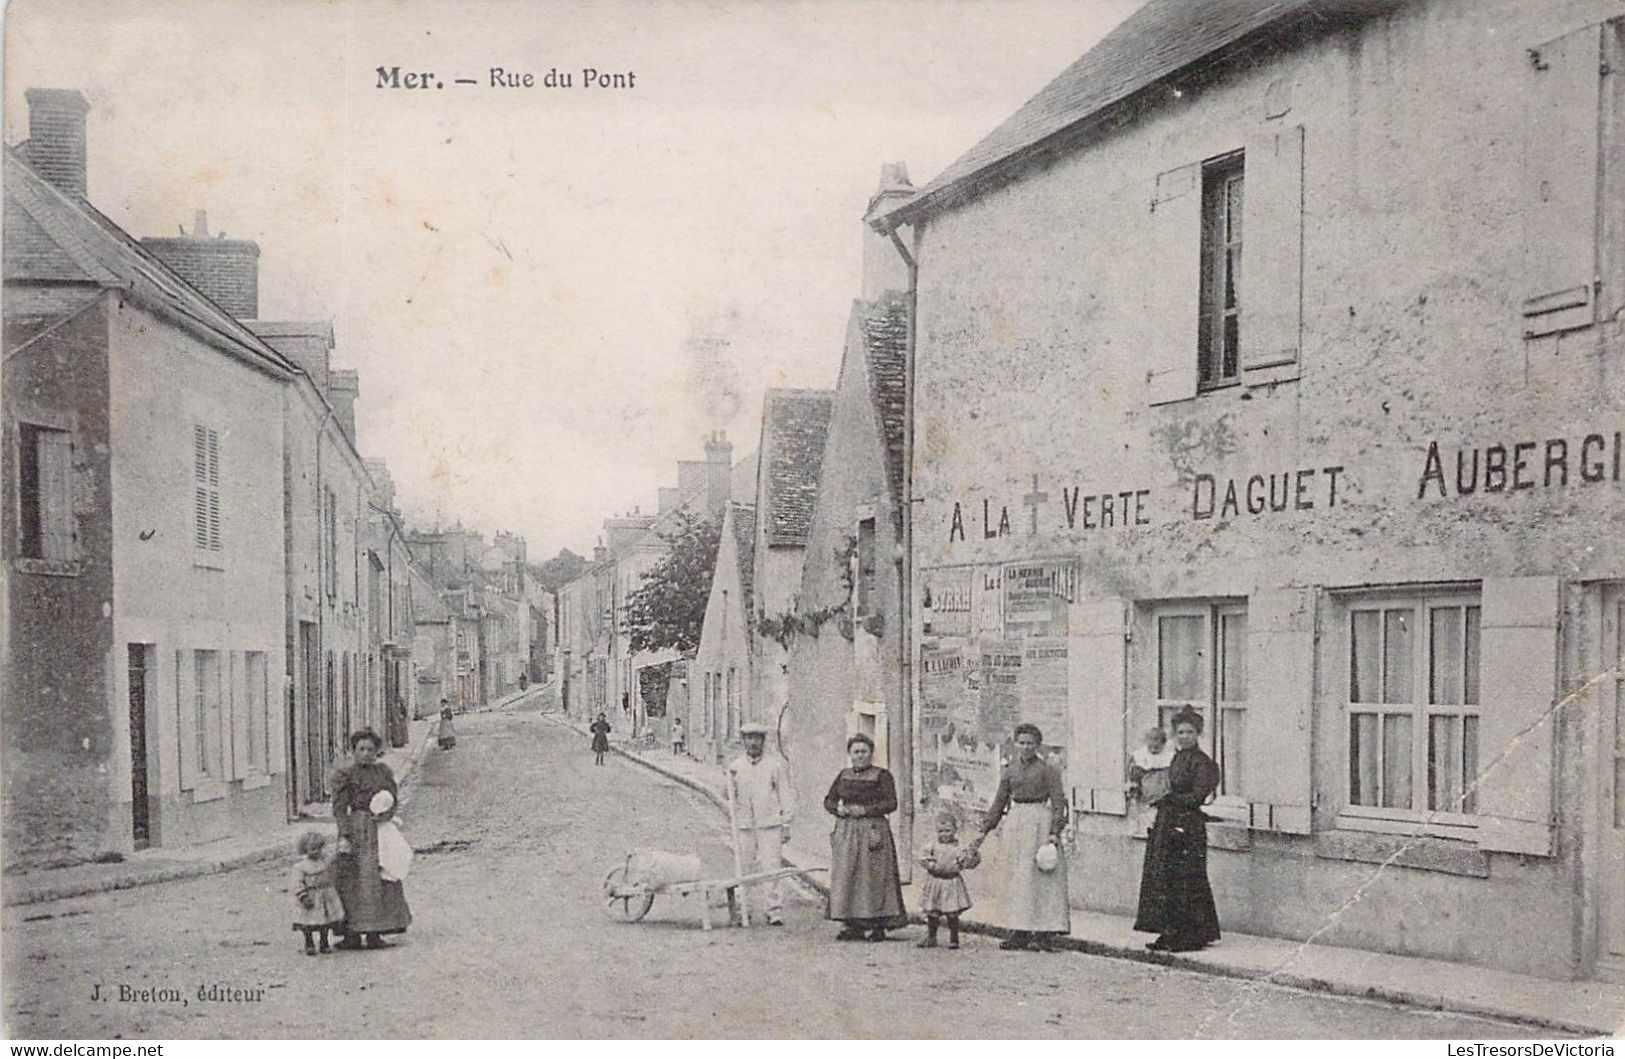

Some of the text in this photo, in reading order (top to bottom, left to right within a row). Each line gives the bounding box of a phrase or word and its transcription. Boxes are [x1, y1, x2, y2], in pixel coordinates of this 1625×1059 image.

[949, 431, 1622, 544] A LA VERTE DAGUET AUBERGI
